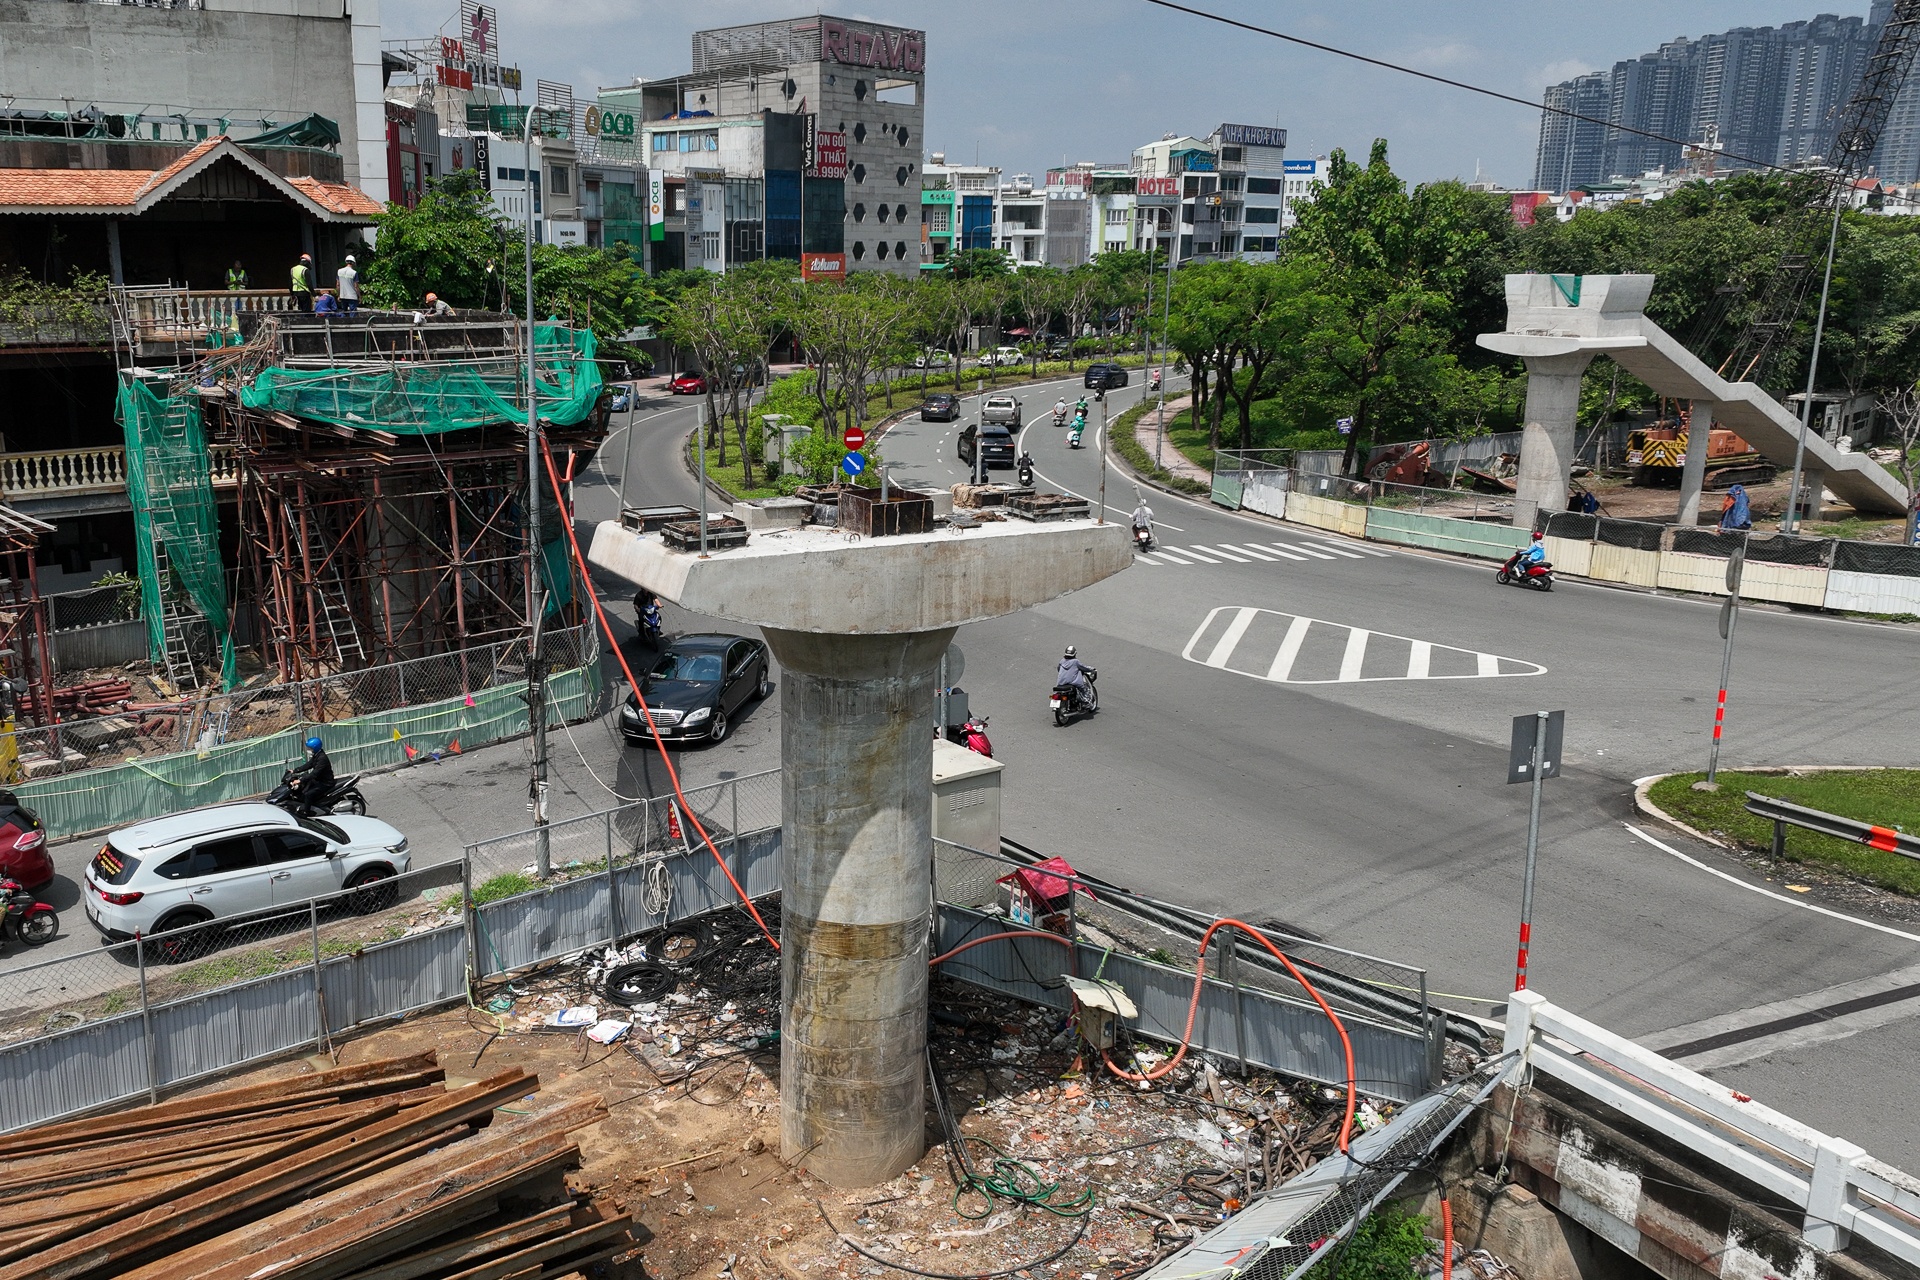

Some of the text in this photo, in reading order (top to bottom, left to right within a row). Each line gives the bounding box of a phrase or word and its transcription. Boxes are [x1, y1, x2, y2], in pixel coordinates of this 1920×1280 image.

[441, 37, 465, 61] SPA
[601, 111, 634, 135] OCB
[805, 115, 813, 148] Canvas
[832, 133, 846, 147] GÓI
[1244, 127, 1268, 145] KHOA
[476, 140, 487, 190] HOTEL
[823, 149, 846, 164] THẤT
[1138, 178, 1179, 195] HOTEL
